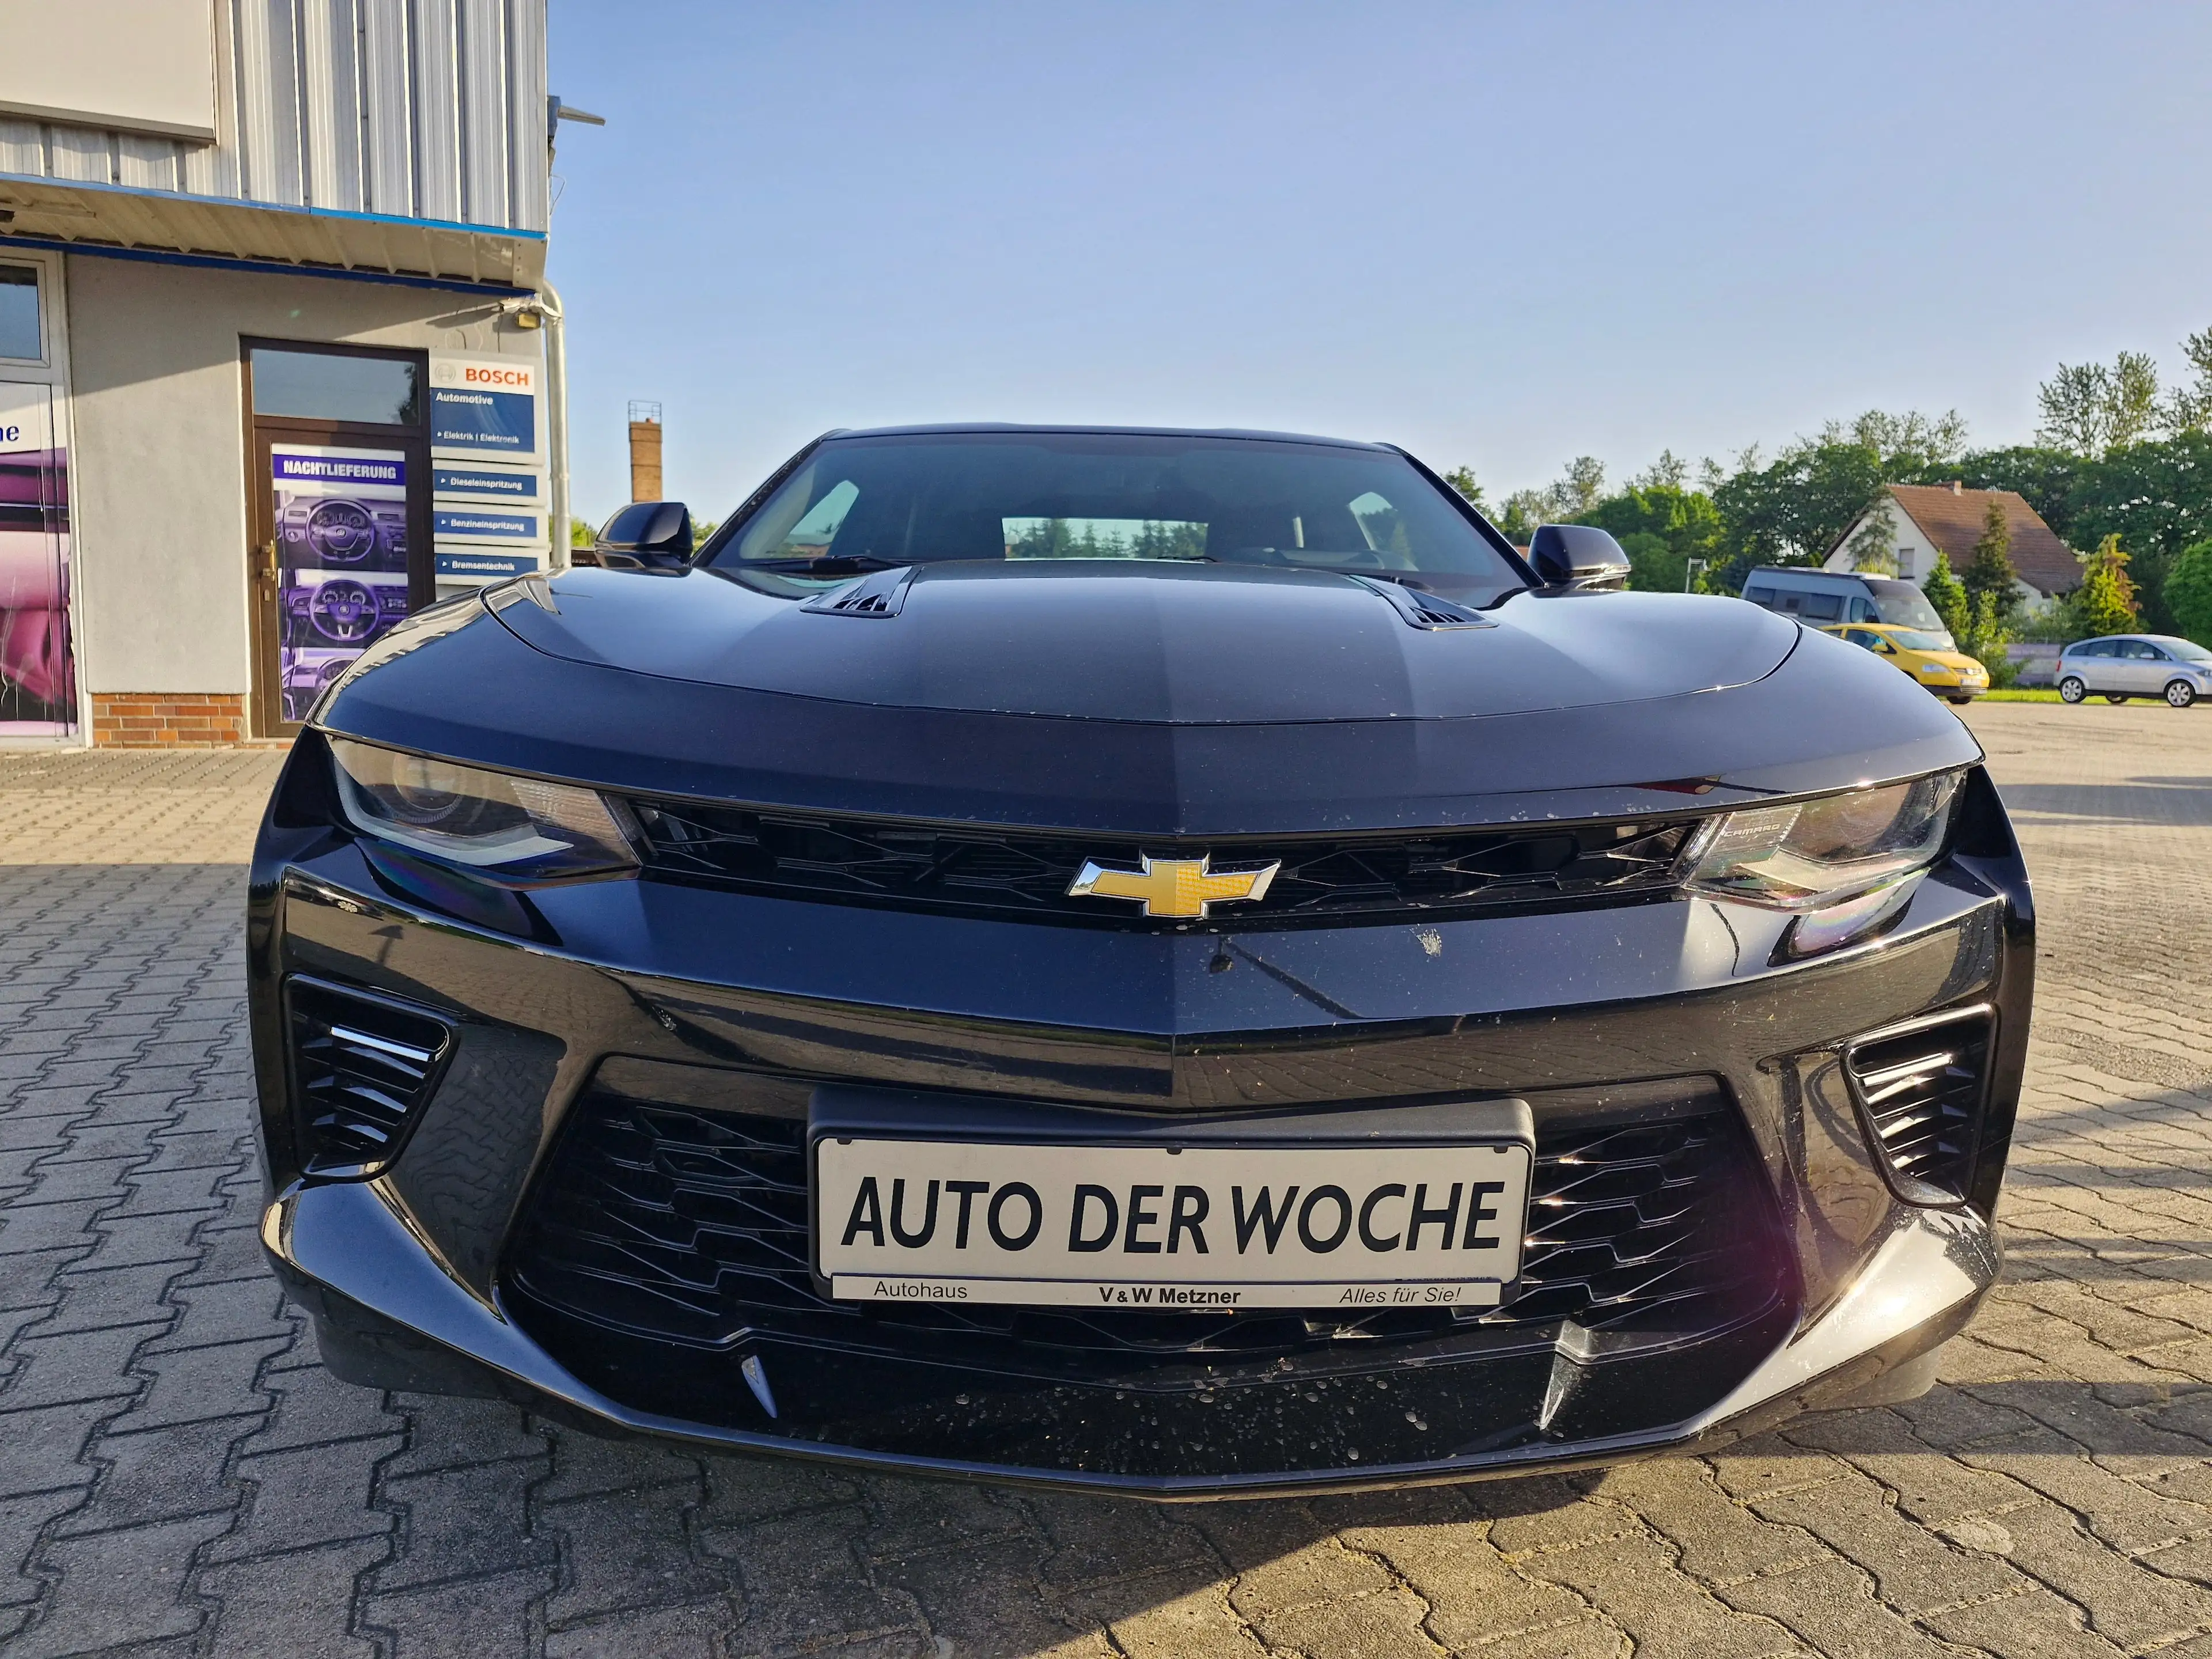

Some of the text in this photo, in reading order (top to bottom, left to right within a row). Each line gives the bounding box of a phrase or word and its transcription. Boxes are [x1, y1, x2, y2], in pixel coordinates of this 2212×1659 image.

[465, 368, 529, 386] BOSCH
[435, 391, 493, 405] Automotive
[444, 430, 474, 441] Elektrik
[480, 433, 520, 444] Elektronik
[283, 460, 396, 479] NACHTLIEFERUNG
[450, 477, 522, 491] Dieseleinspritzung
[451, 518, 524, 532] Benzineinspritzung
[452, 560, 515, 571] Bremsentechnik
[1724, 824, 1780, 837] CAMARO
[840, 1176, 1505, 1255] AUTO DER WOCHE
[874, 1281, 968, 1298] Autohaus
[1099, 1287, 1241, 1304] V & W Metzner
[1339, 1287, 1461, 1303] Alles für Sie!
